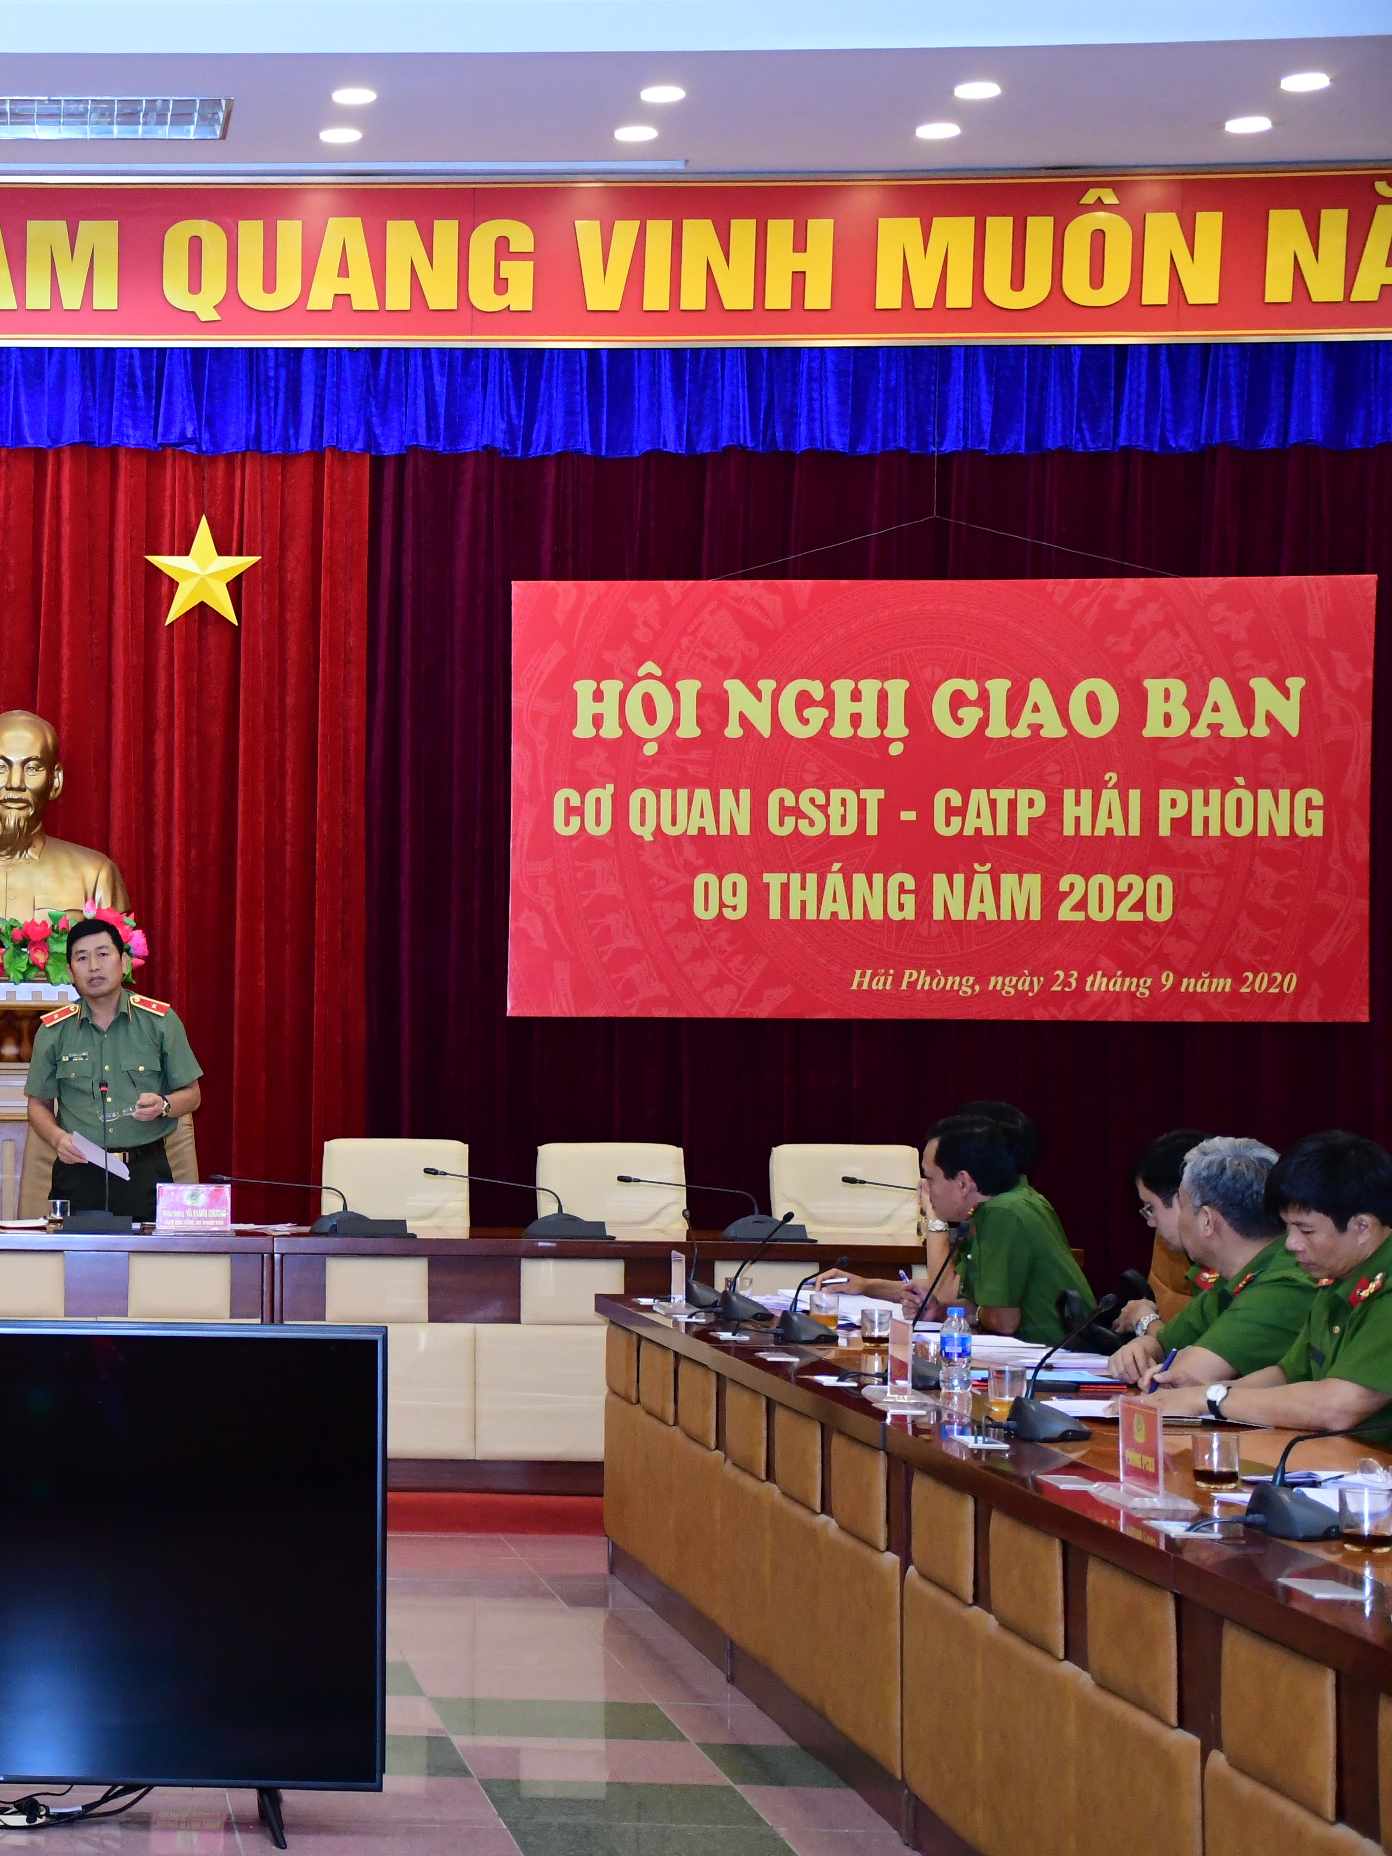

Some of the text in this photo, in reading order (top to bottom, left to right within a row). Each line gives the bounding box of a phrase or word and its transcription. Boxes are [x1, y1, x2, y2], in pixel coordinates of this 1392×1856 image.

[163, 217, 535, 321] QUANG
[575, 218, 834, 311] VINH
[875, 188, 1223, 309] MUÔN
[573, 661, 1306, 755] HỘI NGHỊ GIAO BAN
[553, 783, 615, 836] CƠ
[628, 787, 751, 840] QUAN
[767, 788, 885, 837] CSĐT
[933, 788, 1046, 837] CATP
[1063, 772, 1141, 837] HẢI
[1158, 775, 1324, 837] PHÒNG
[693, 862, 1173, 922] 09 THÁNG NĂM 2020
[850, 968, 1297, 998] Hải Phòng, ngày 23 tháng 9 năm 2020
